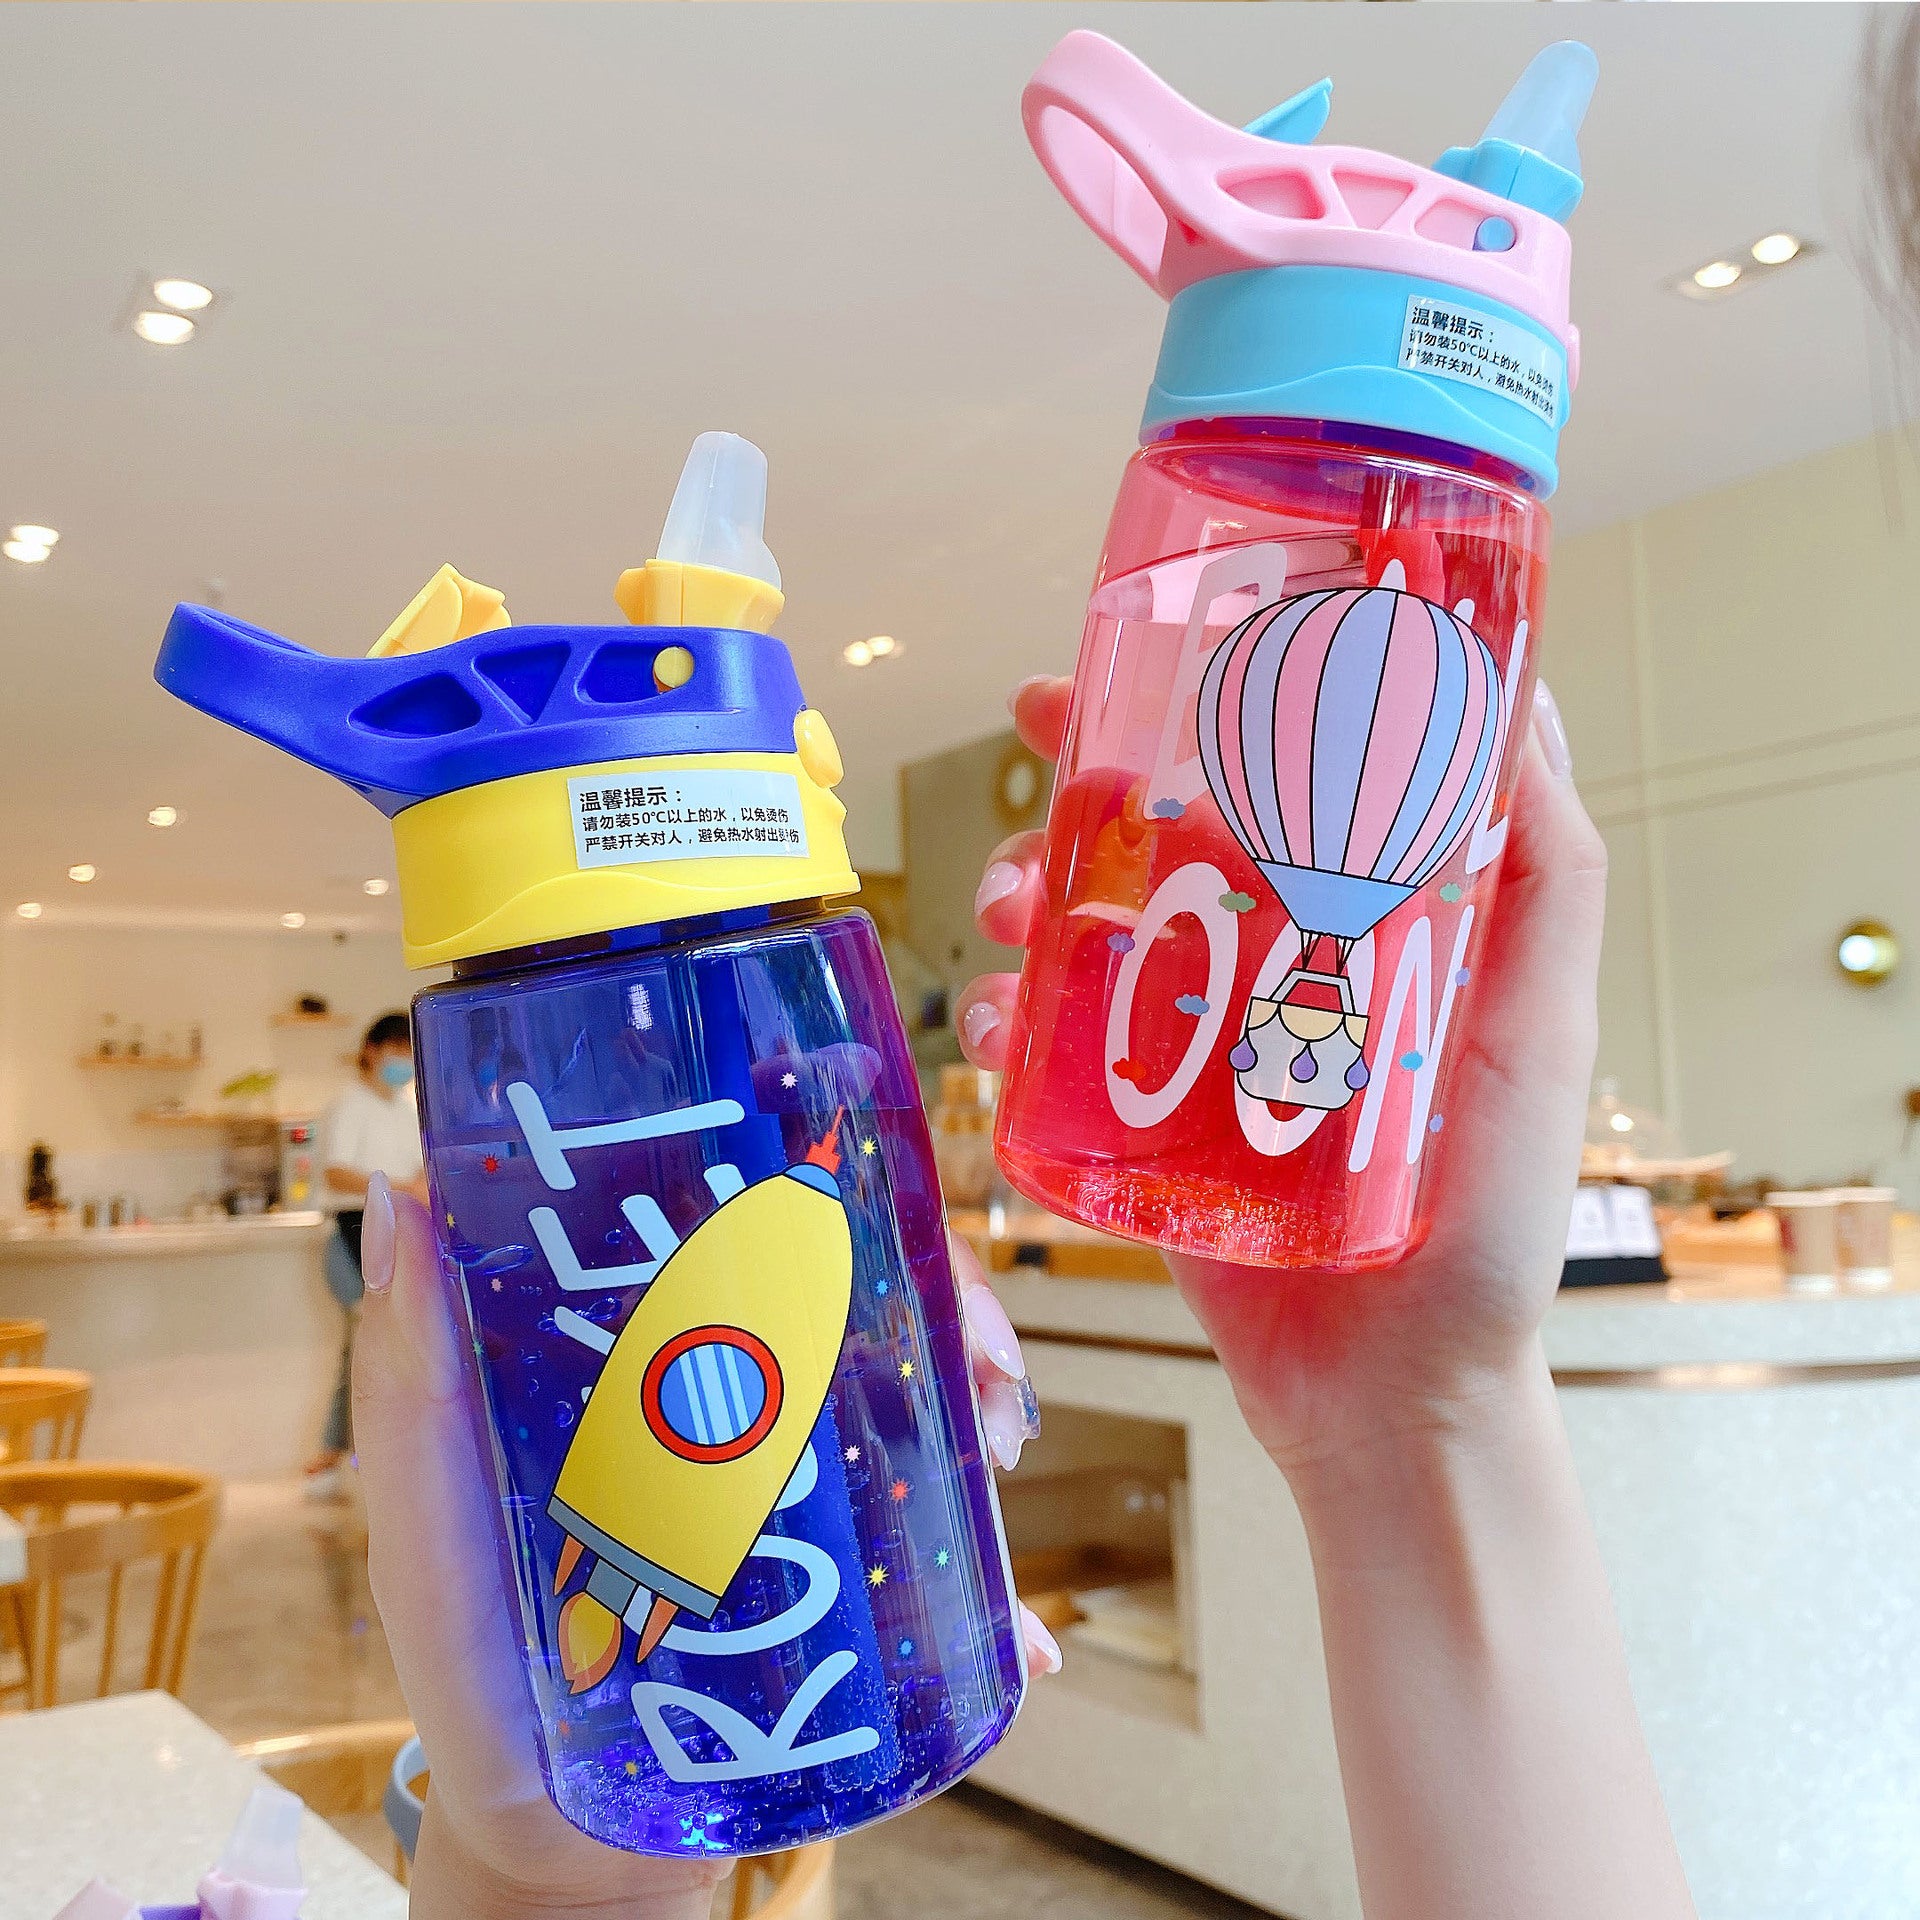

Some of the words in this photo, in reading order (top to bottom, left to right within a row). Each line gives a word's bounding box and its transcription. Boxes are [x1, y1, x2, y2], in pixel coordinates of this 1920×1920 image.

[1412, 306, 1494, 343] 温馨提示：
[579, 786, 682, 813] 温馨提示：
[582, 807, 789, 832] 请勿装50℃以上的水，以免烫伤
[585, 827, 800, 852] 严禁开关对人，避免热水射出烫伤
[506, 1080, 880, 1784] ROET
